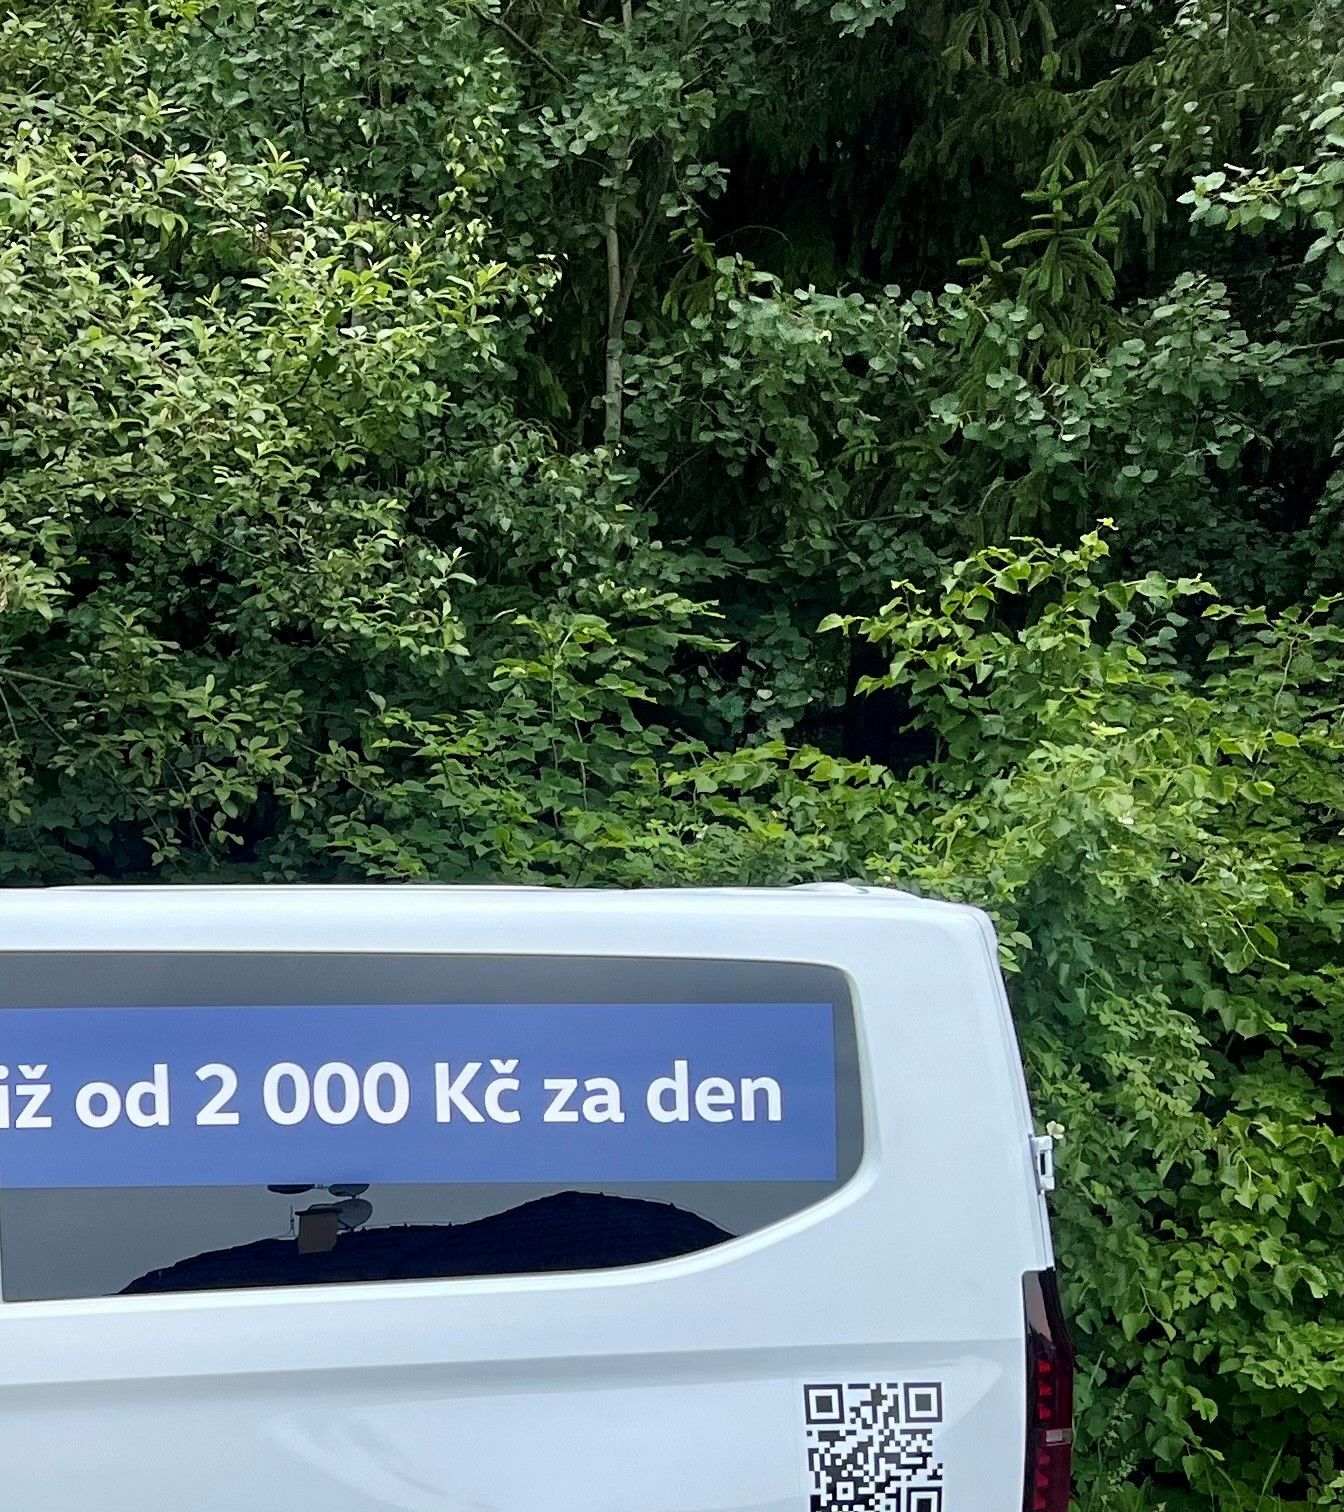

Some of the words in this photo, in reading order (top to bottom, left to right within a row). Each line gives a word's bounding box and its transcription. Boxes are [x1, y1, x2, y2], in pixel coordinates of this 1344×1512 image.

[75, 1063, 170, 1128] od
[195, 1063, 241, 1126] 2
[263, 1061, 410, 1125] 000
[435, 1059, 521, 1124] Kč
[543, 1077, 625, 1123] za
[646, 1059, 782, 1123] den
